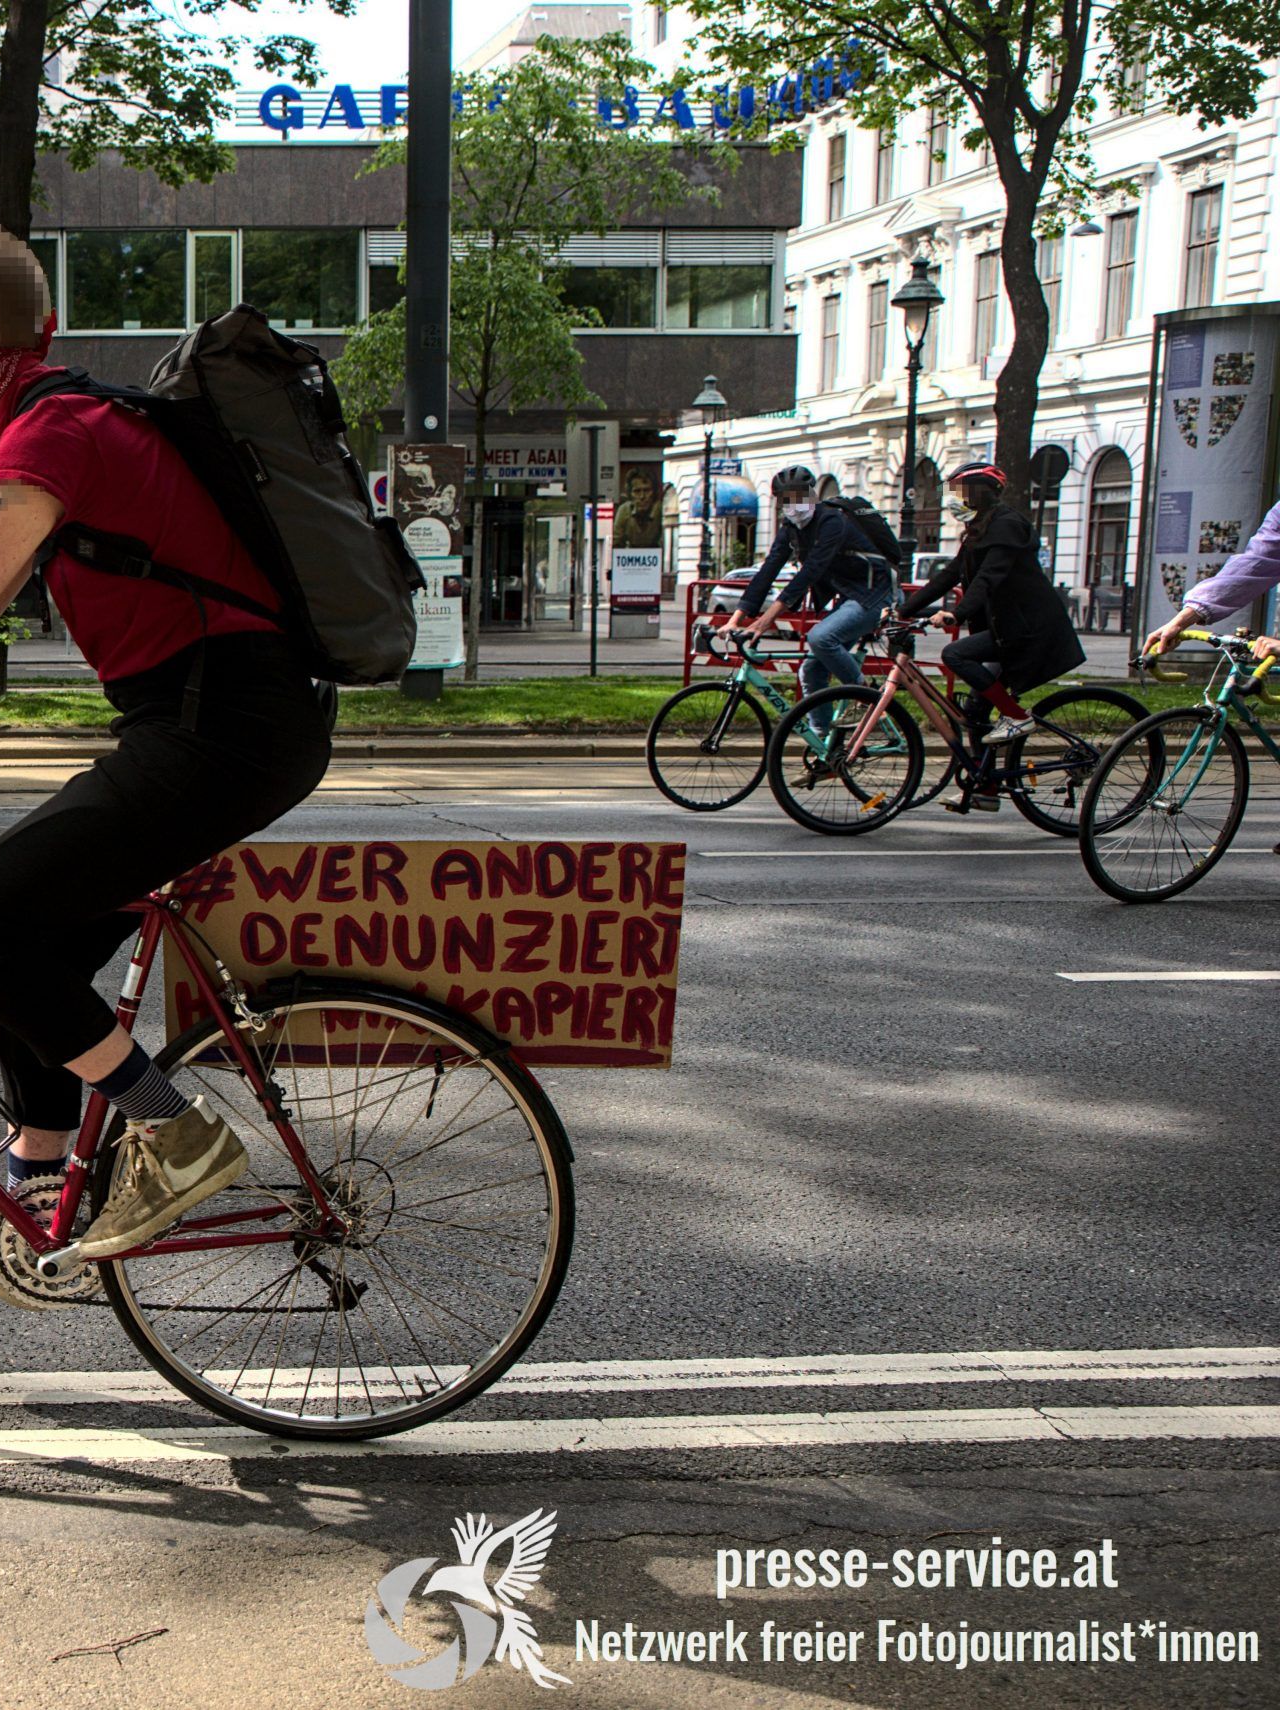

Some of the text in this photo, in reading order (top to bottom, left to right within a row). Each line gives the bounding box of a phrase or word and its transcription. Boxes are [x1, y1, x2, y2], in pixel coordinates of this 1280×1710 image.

[484, 449, 519, 465] MEET
[529, 467, 555, 477] KNOW
[616, 555, 658, 567] TOMMASO
[430, 842, 686, 909] ANDERE
[239, 909, 681, 979] DENUNZIERT
[446, 980, 674, 1048] KAPIERT
